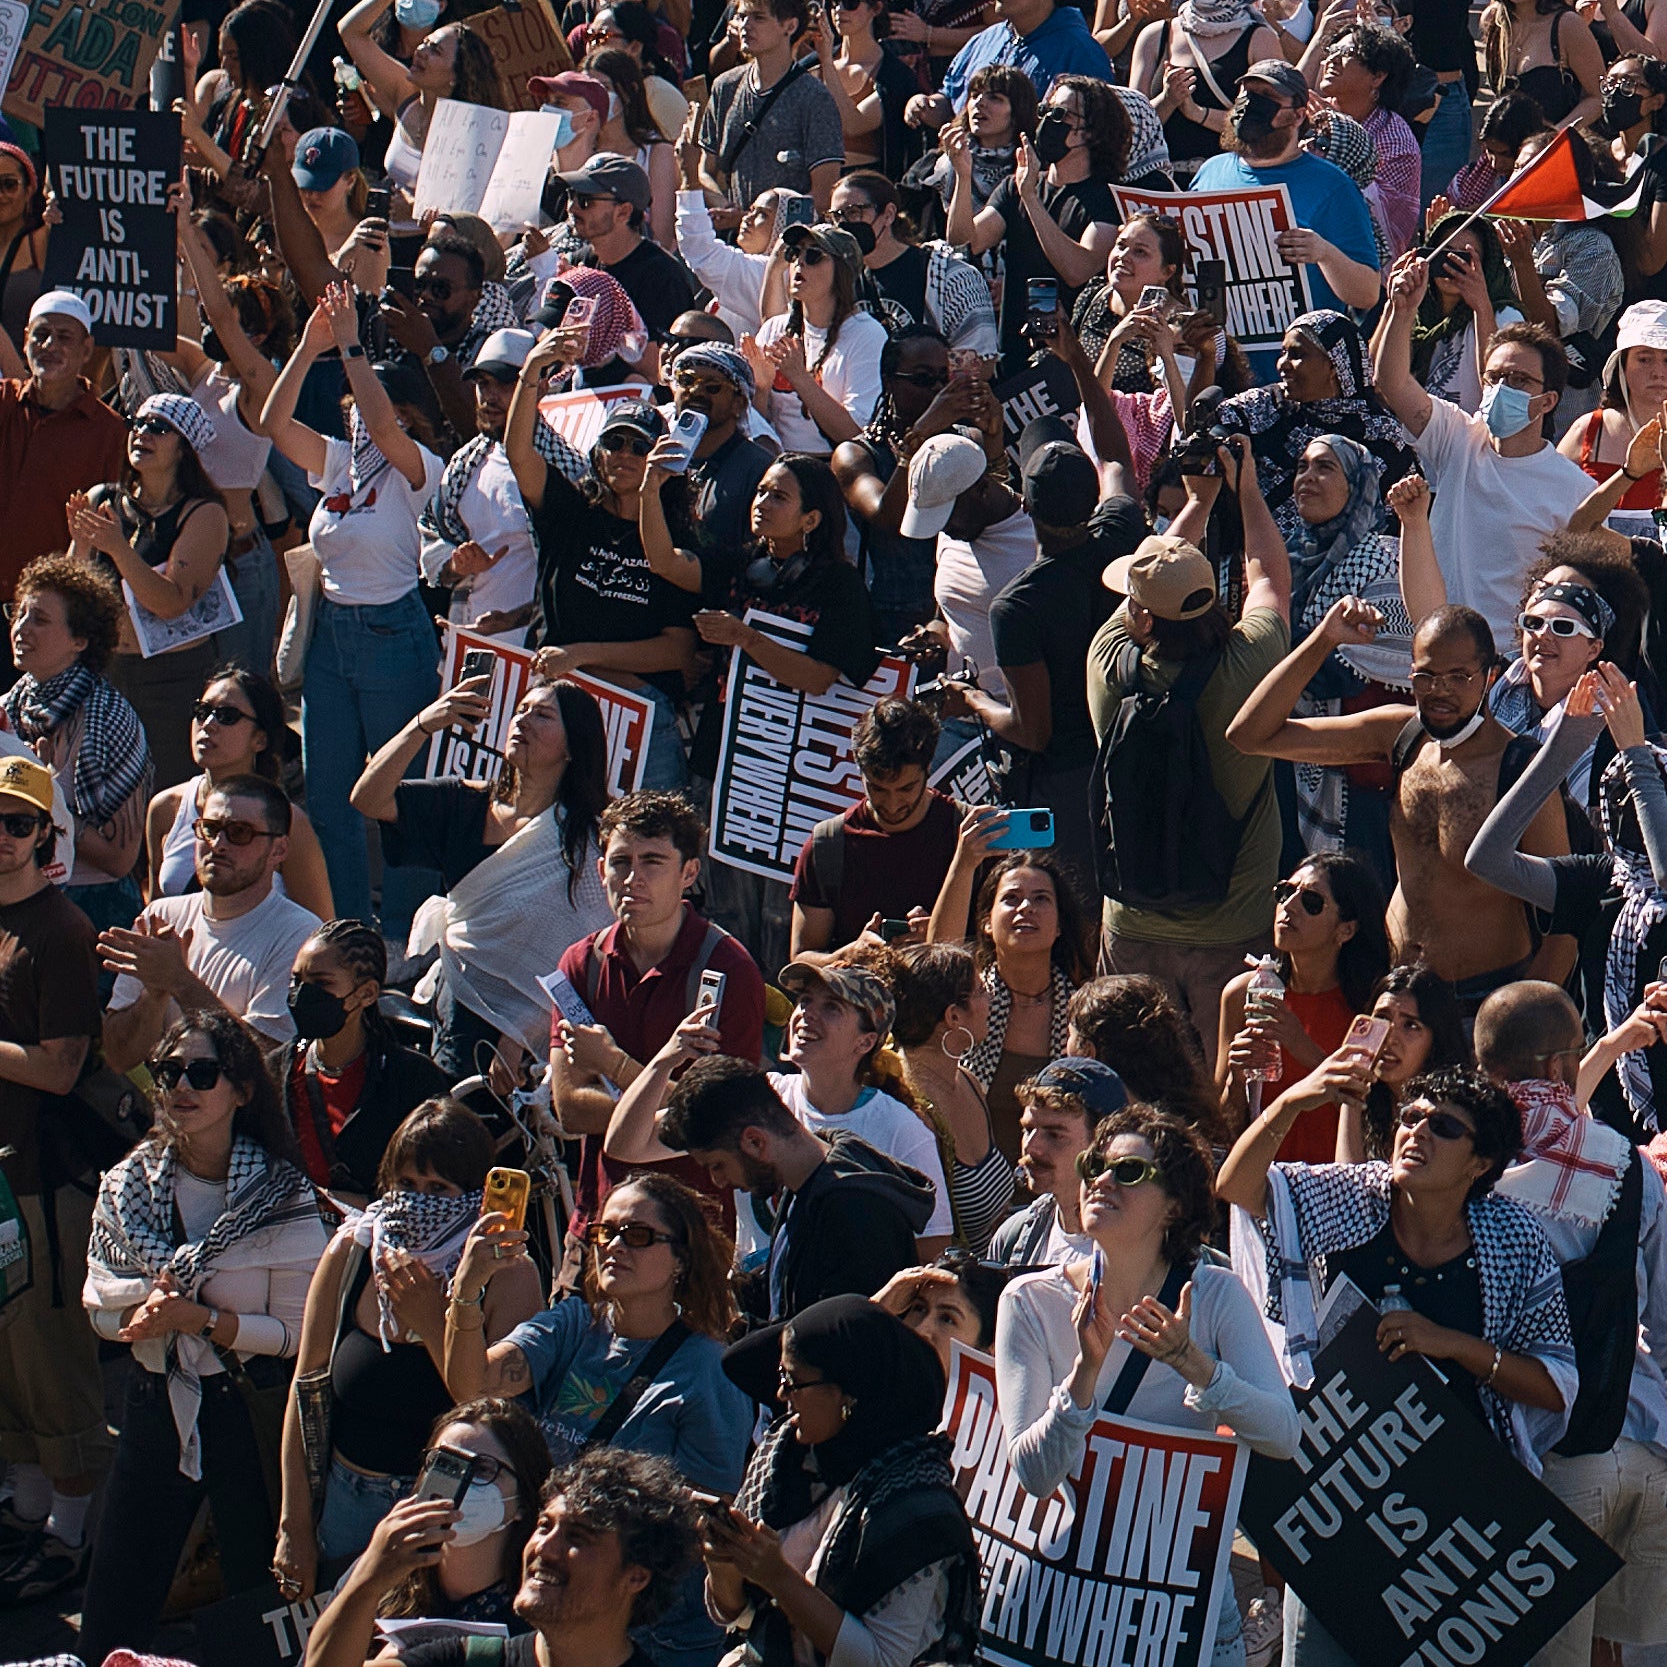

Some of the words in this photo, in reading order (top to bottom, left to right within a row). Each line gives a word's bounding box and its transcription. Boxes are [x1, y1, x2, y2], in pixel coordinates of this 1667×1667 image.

[80, 125, 136, 163] THE
[59, 164, 166, 206] FUTURE
[99, 208, 126, 244] IS
[76, 247, 149, 286] ANTI-
[54, 285, 169, 329] ONIST
[1001, 380, 1059, 434] THE
[722, 665, 799, 860] EVERYWHERE
[1273, 1383, 1445, 1565] FUTURE
[1365, 1492, 1428, 1559] IS
[1381, 1516, 1502, 1639] ANTI-
